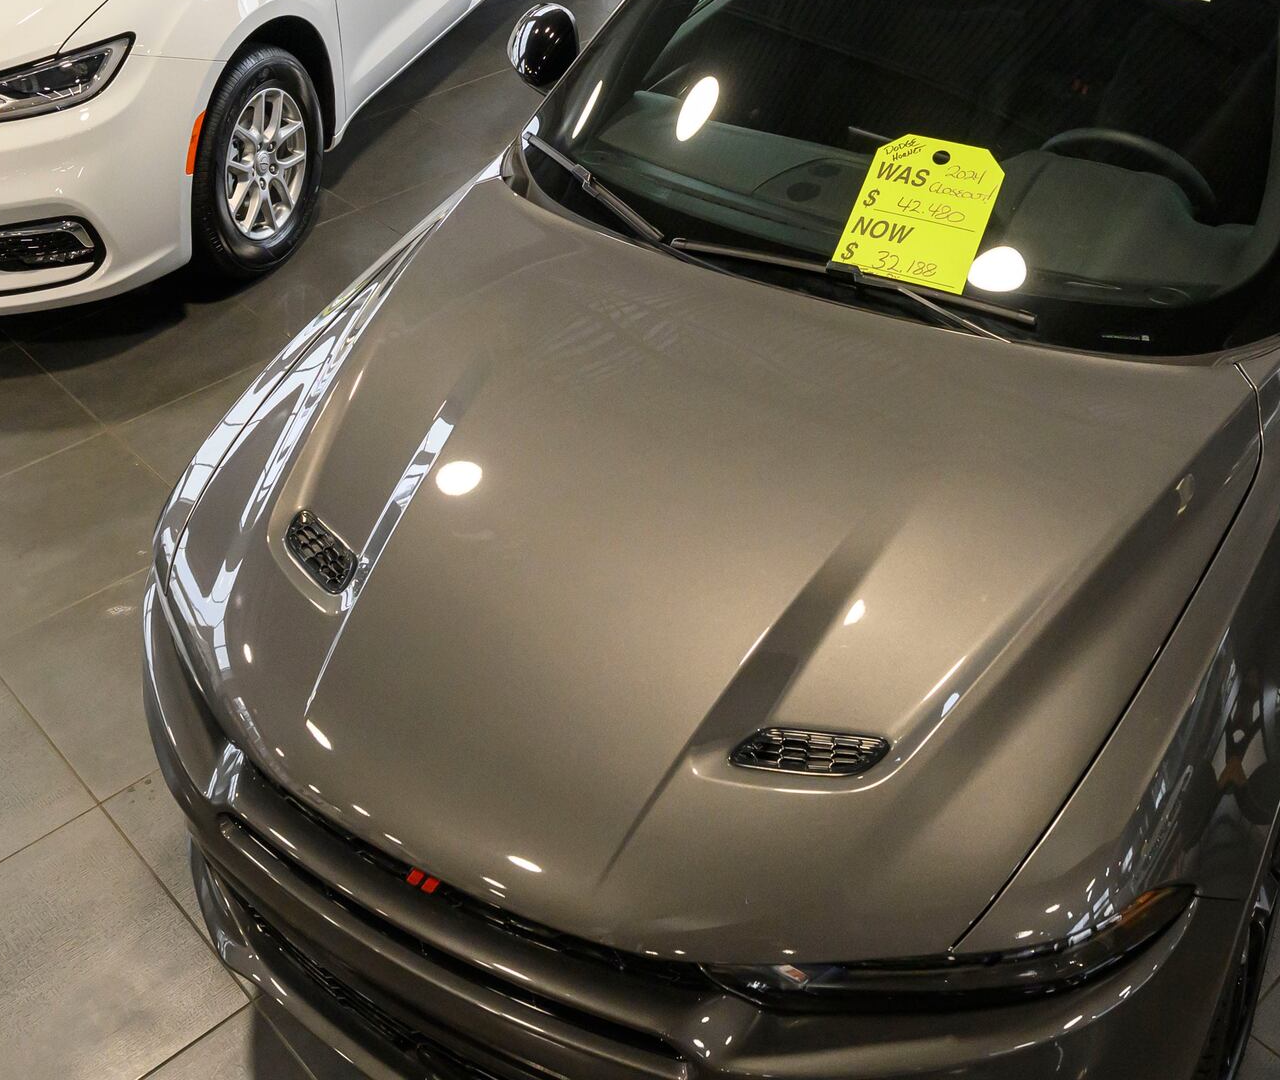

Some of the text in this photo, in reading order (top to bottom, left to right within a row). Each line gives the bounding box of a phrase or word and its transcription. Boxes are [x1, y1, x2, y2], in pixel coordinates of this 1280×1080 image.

[883, 138, 920, 156] DODGE
[876, 161, 930, 187] WAS
[945, 165, 988, 184] 2024
[862, 188, 880, 209] $
[850, 216, 914, 244] NOW
[840, 242, 859, 262] $
